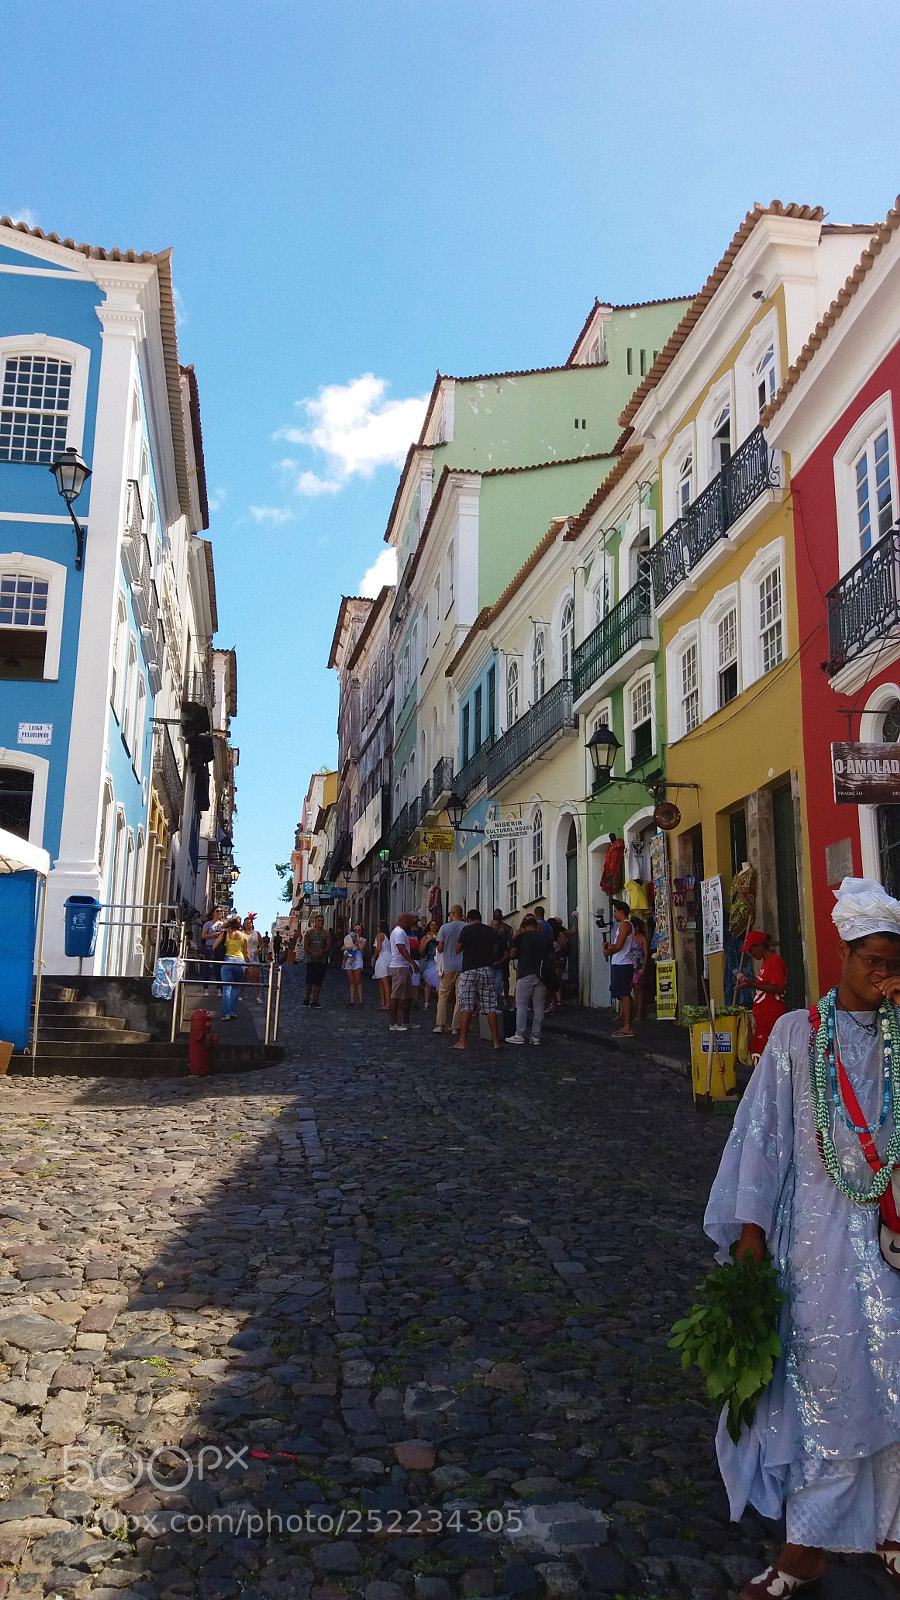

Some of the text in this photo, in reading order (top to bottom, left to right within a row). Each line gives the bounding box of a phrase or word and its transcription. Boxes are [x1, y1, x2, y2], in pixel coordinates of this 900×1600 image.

[835, 759, 844, 774] O
[494, 820, 523, 828] NIGERIA
[485, 827, 514, 835] CULTURAL
